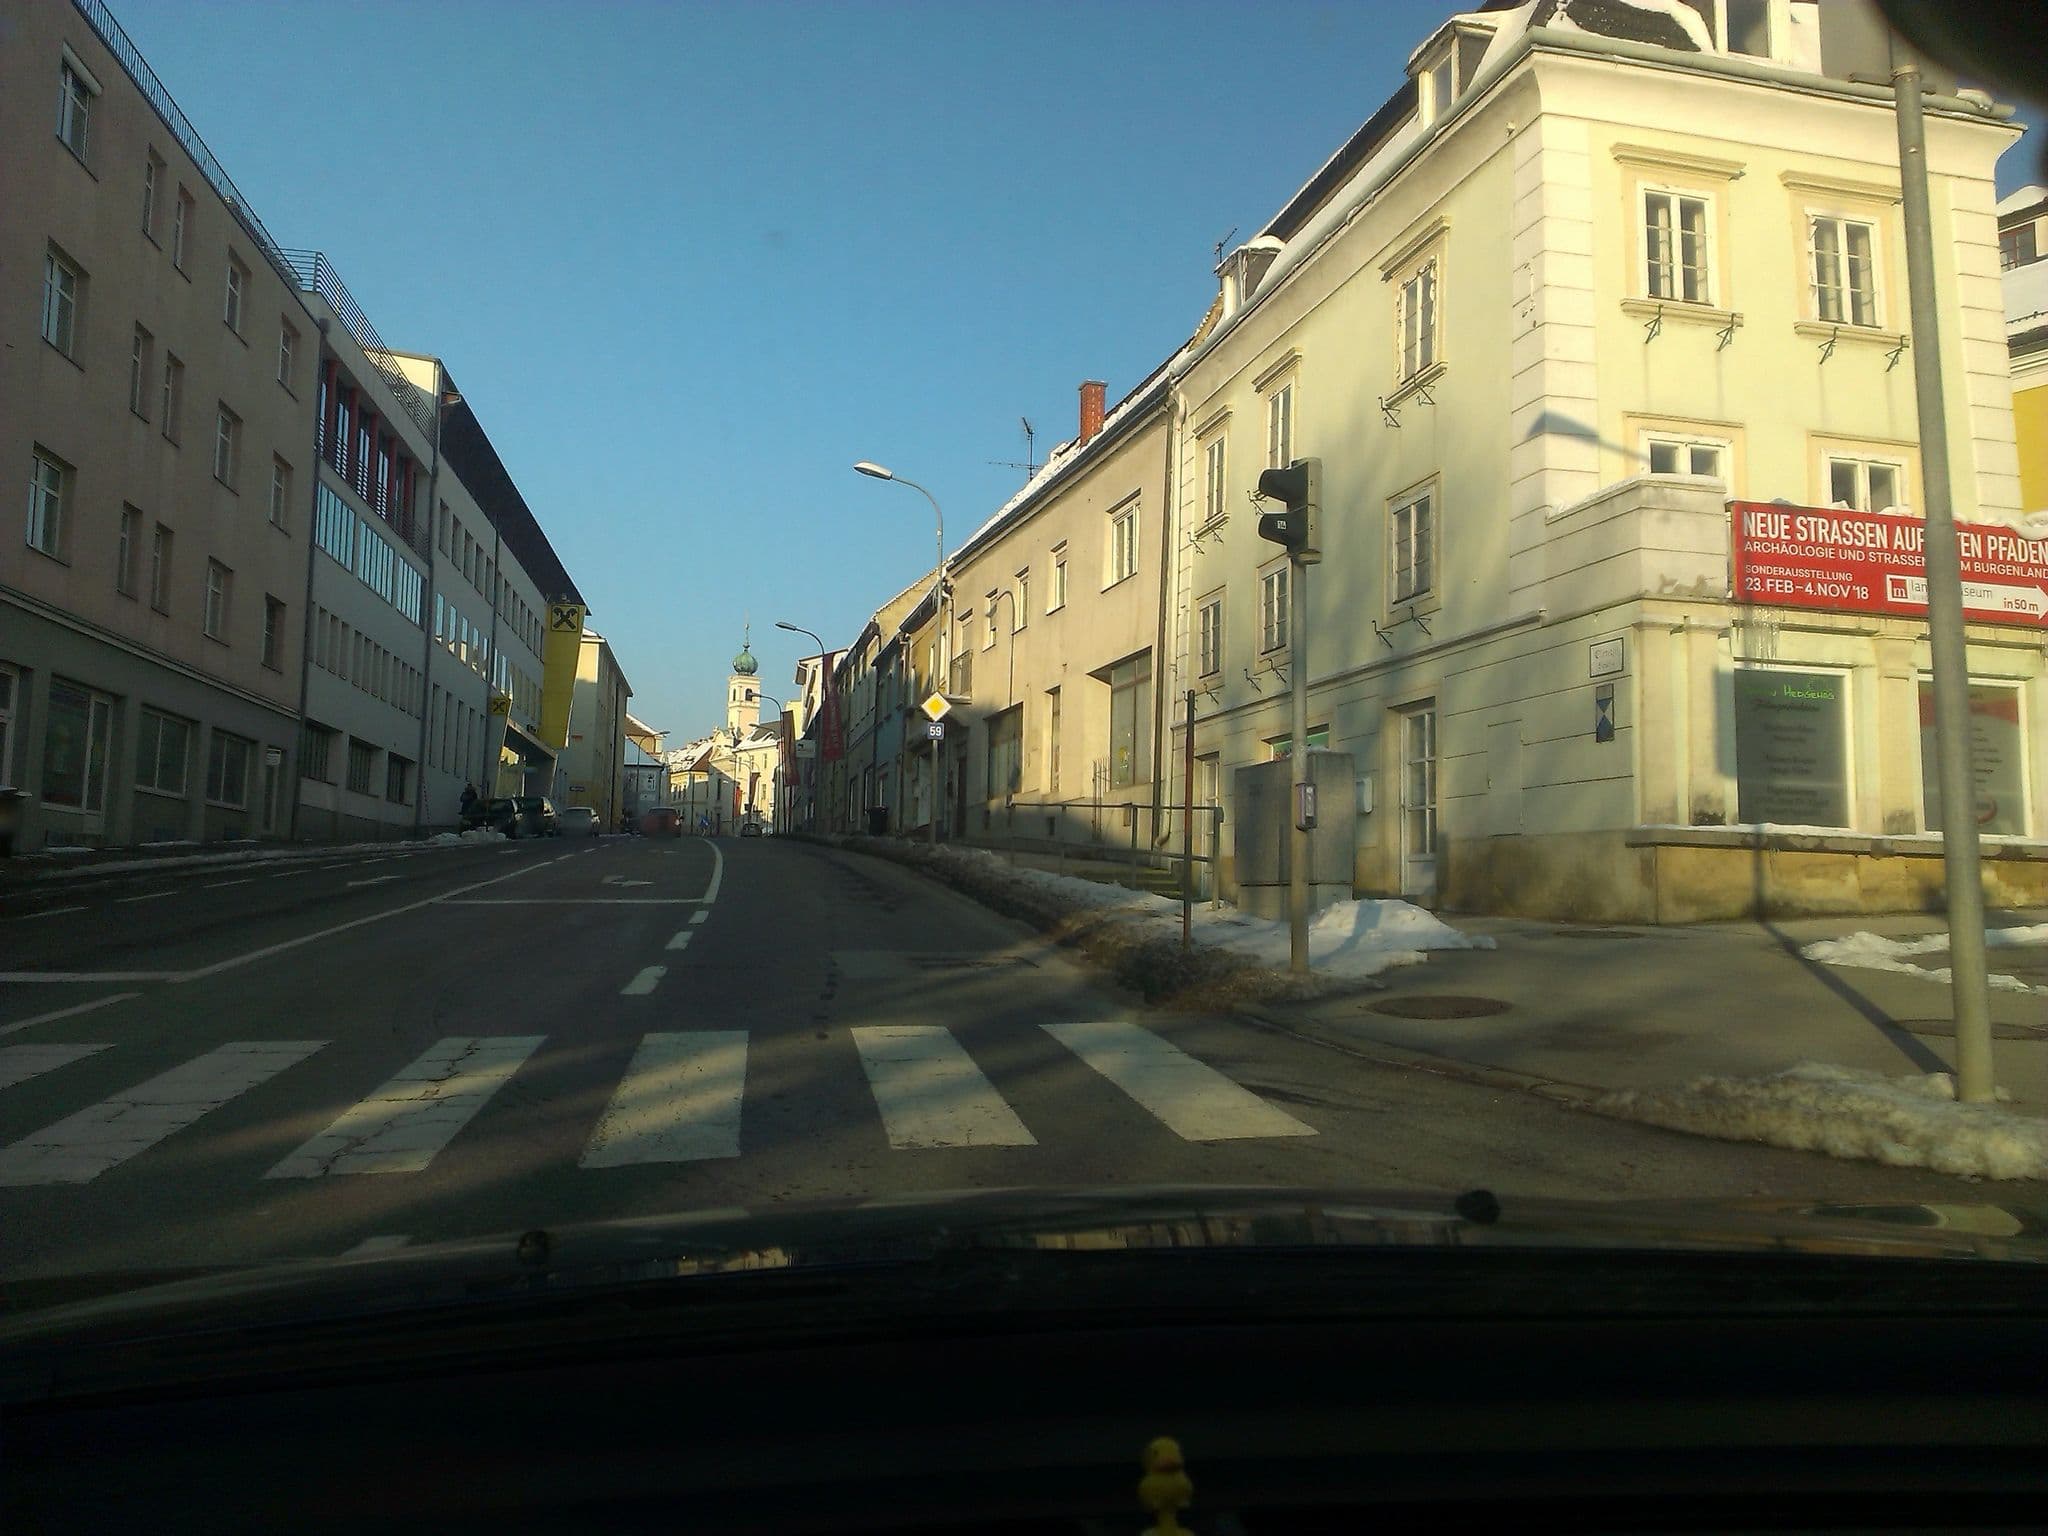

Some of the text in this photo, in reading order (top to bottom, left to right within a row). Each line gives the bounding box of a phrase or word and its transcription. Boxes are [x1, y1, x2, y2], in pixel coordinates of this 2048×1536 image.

[1743, 511, 1791, 540] NEUE
[1796, 515, 1888, 549] STRASSEN
[1987, 535, 2048, 565] PFADEN
[1744, 541, 1835, 559] ARCHÄOLOGIE
[1839, 551, 1865, 562] UND
[1745, 565, 1853, 581] SONDERAUSSTELLUNG
[2014, 599, 2027, 610] 50
[2028, 603, 2039, 612] m
[930, 726, 942, 737] 59
